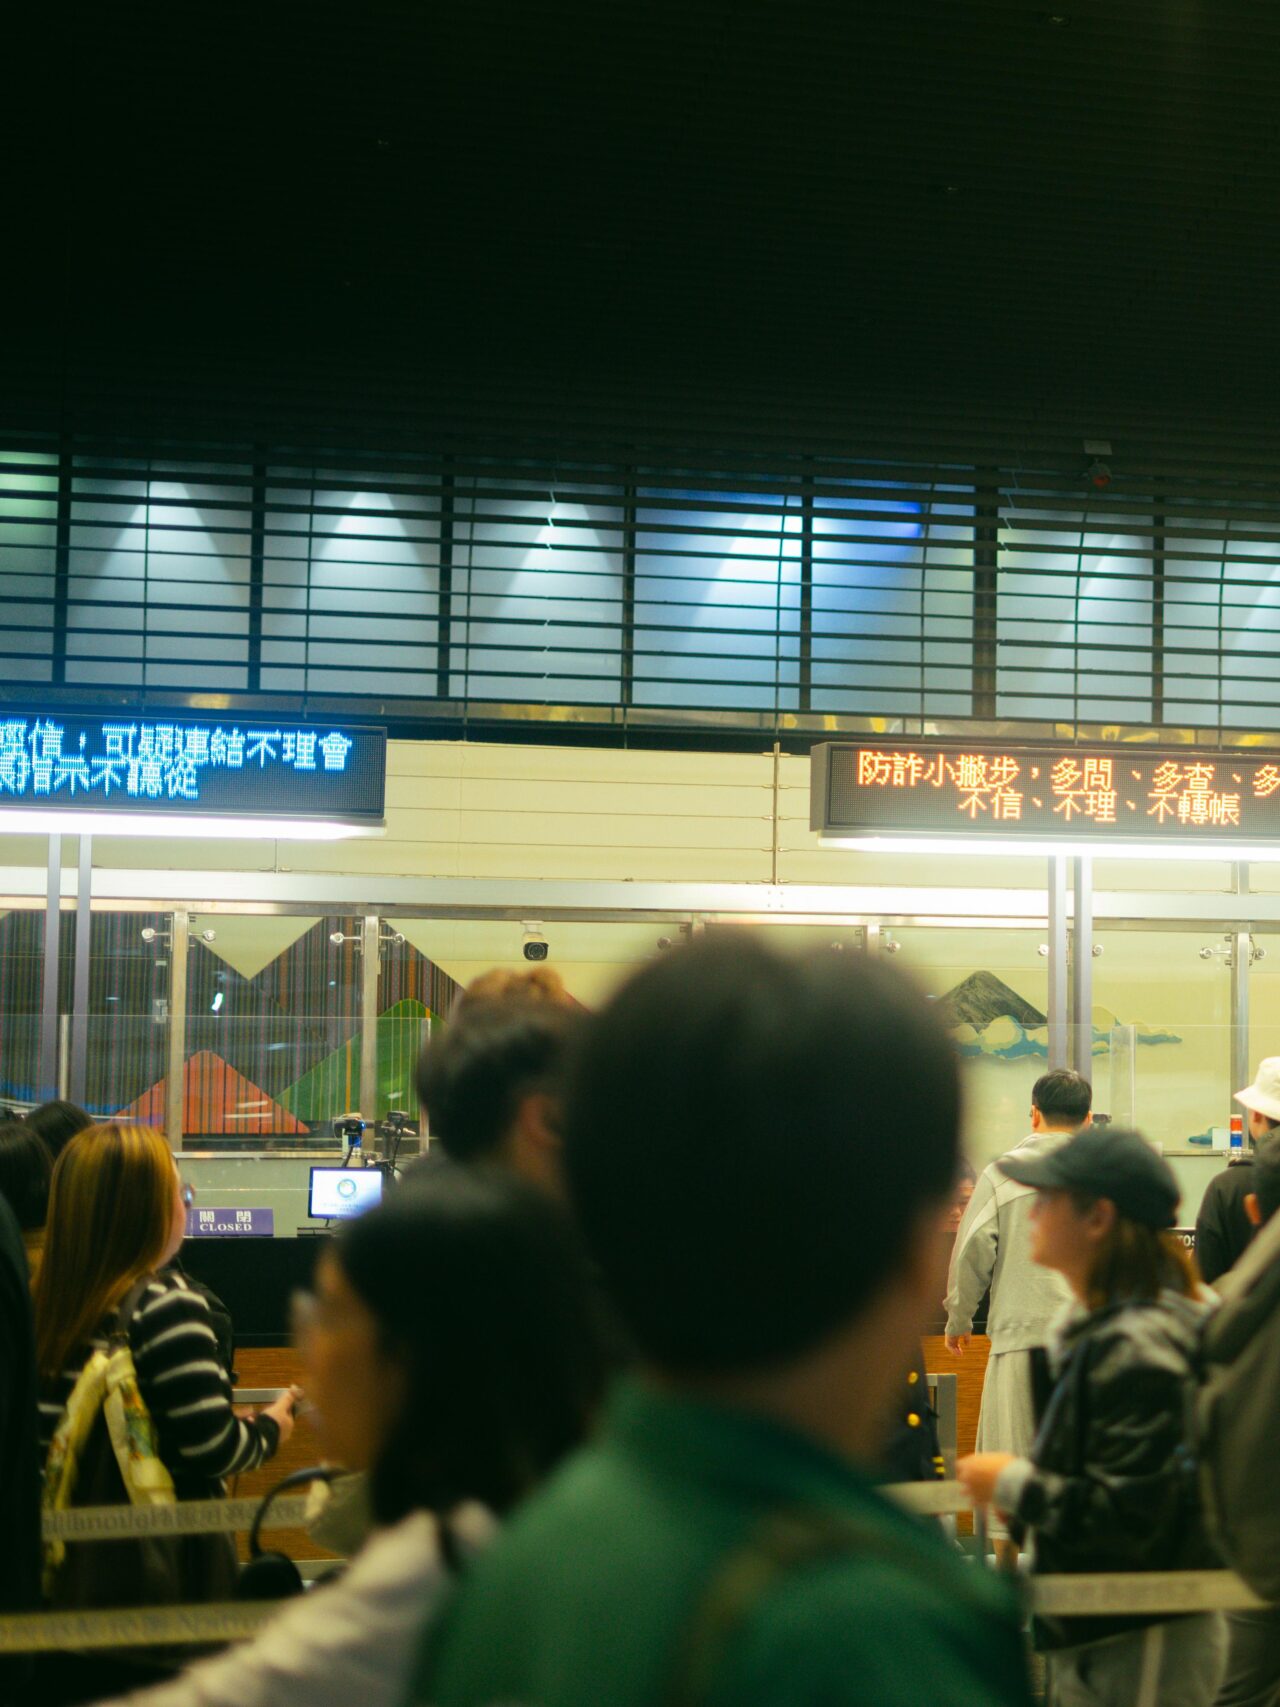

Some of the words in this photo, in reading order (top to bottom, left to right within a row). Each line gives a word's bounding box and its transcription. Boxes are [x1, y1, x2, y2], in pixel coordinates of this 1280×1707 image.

[957, 786, 1241, 827] 不信、不理、不轉帳
[199, 1223, 252, 1232] CLOSED
